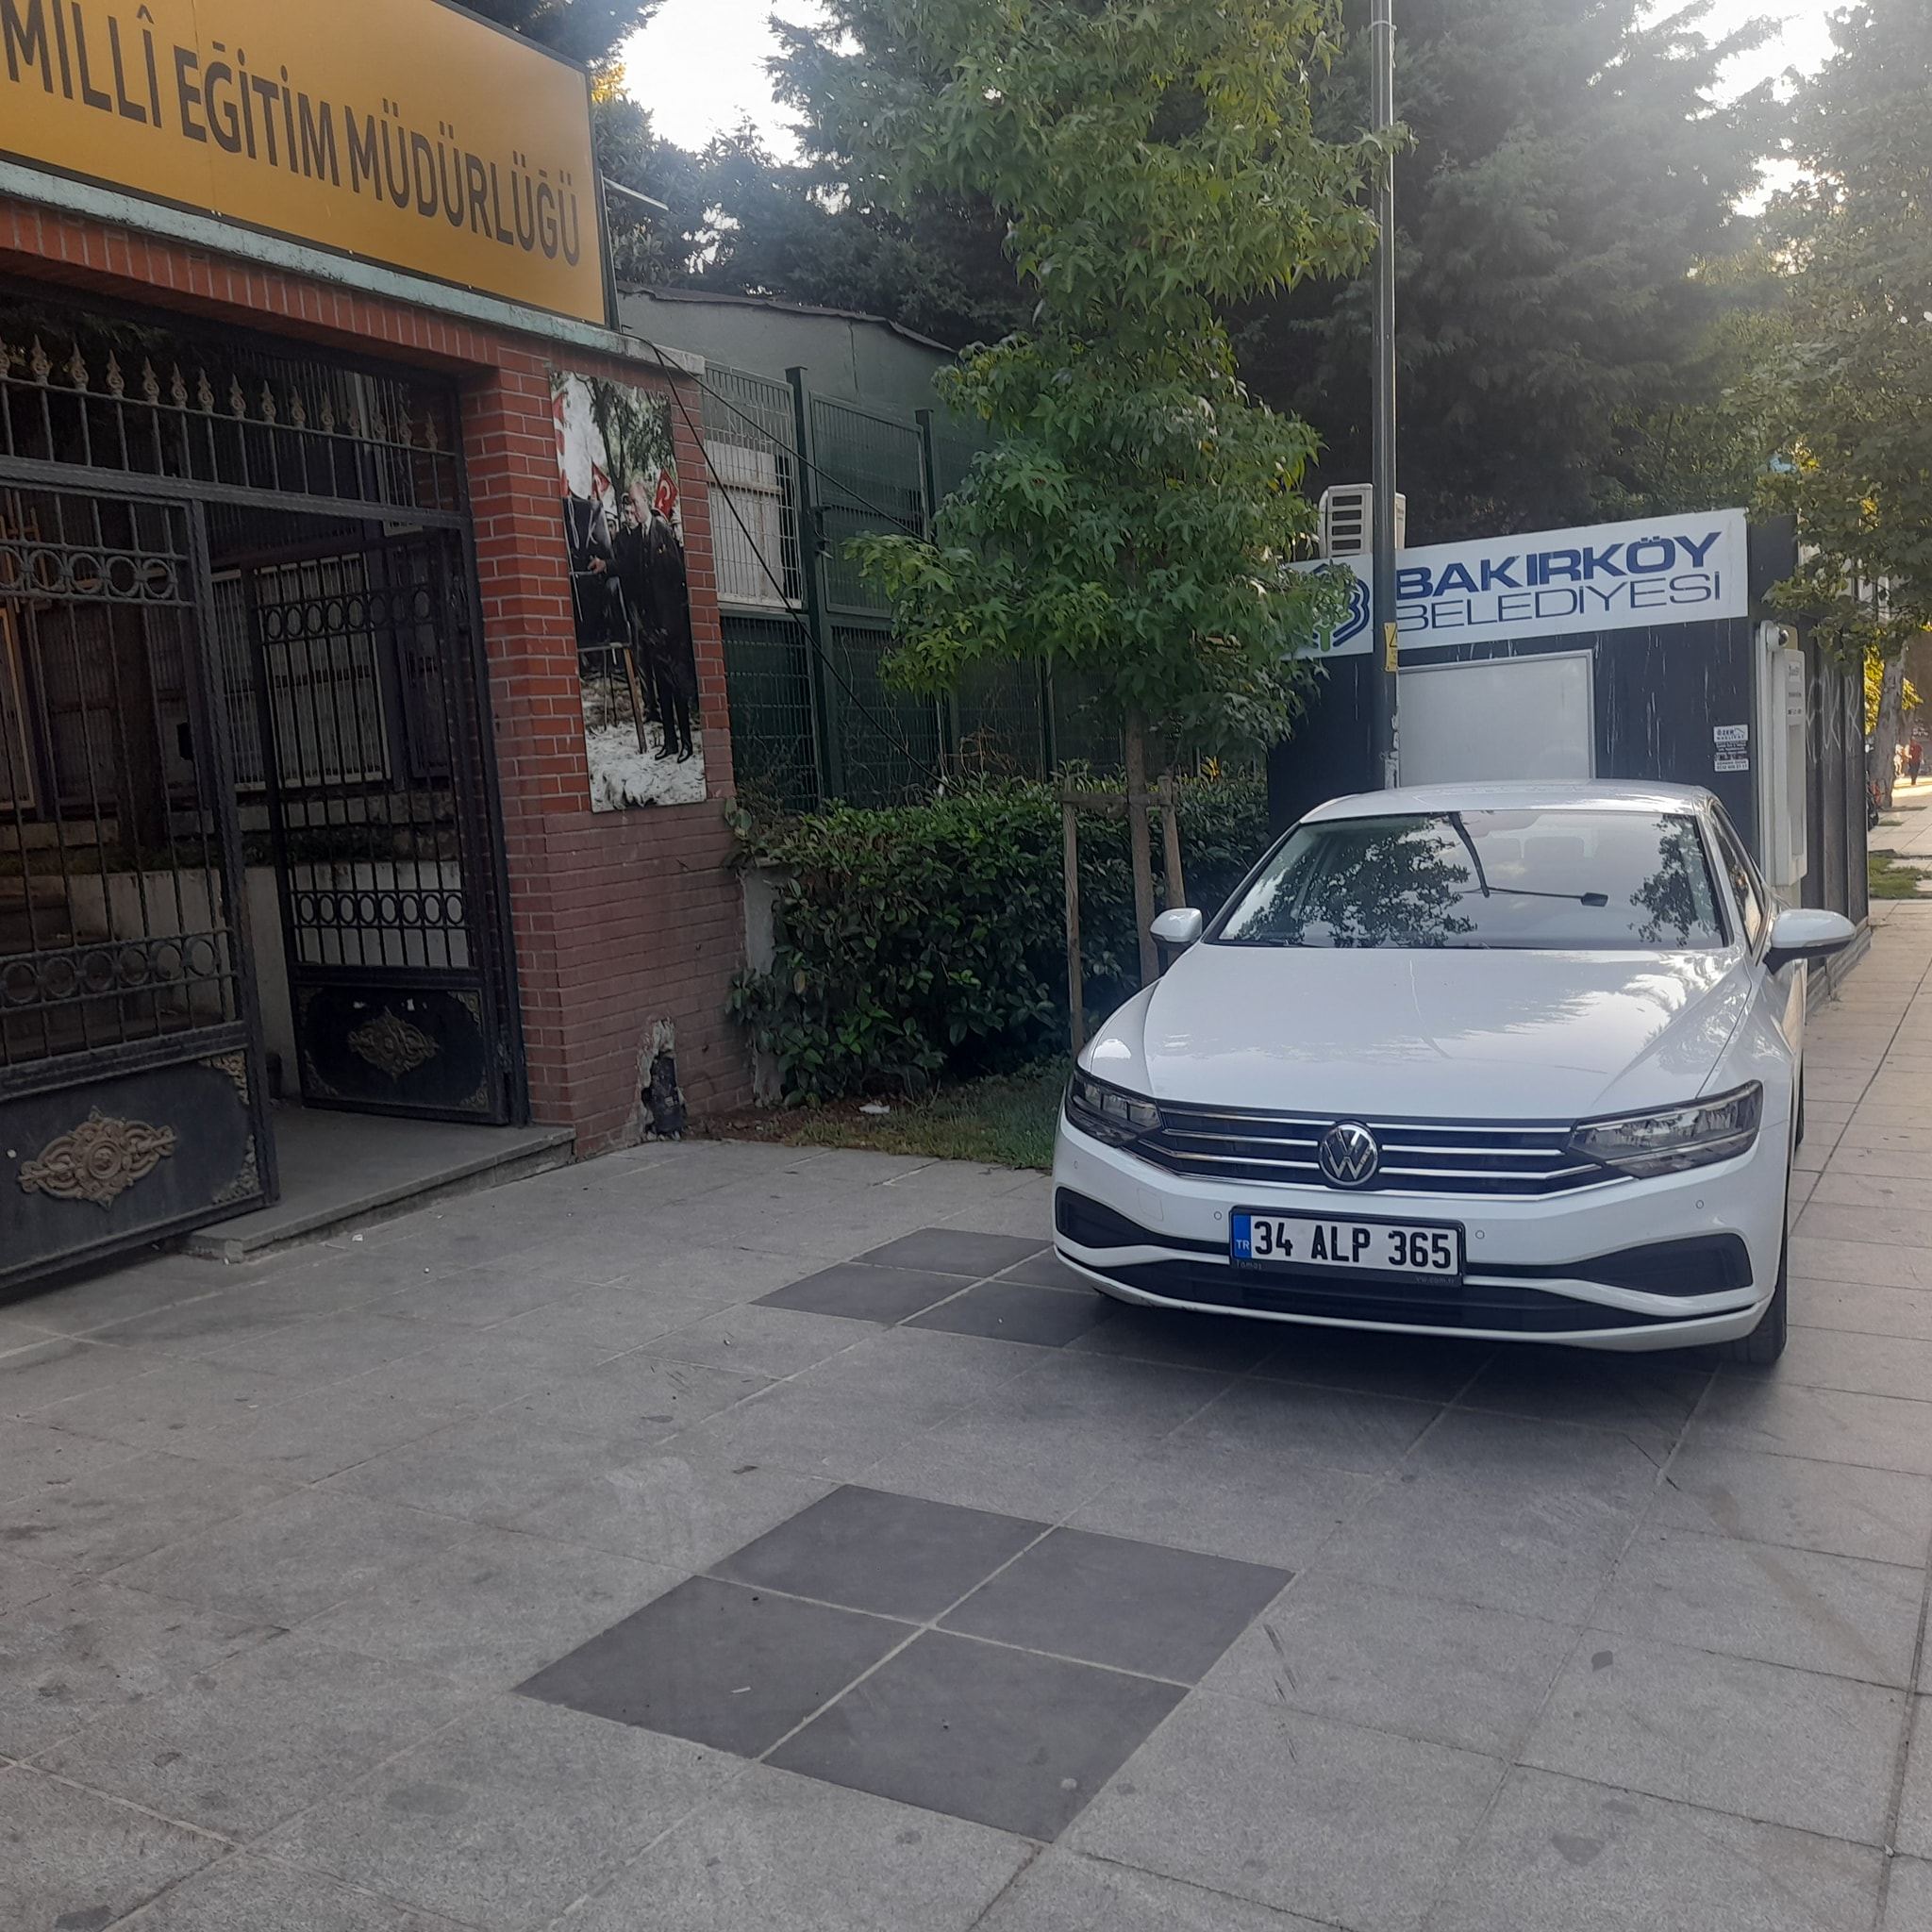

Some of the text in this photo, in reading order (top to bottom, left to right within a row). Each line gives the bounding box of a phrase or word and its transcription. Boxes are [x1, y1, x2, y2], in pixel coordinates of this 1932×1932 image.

[173, 41, 341, 188] EĞİTİM
[344, 97, 581, 268] MÜDÜRLÜĞÜ
[1395, 531, 1723, 601] BAKIRKÖY
[1396, 571, 1721, 633] BELEDİYESİ
[1236, 1221, 1452, 1270] TR 34 ALP 365
